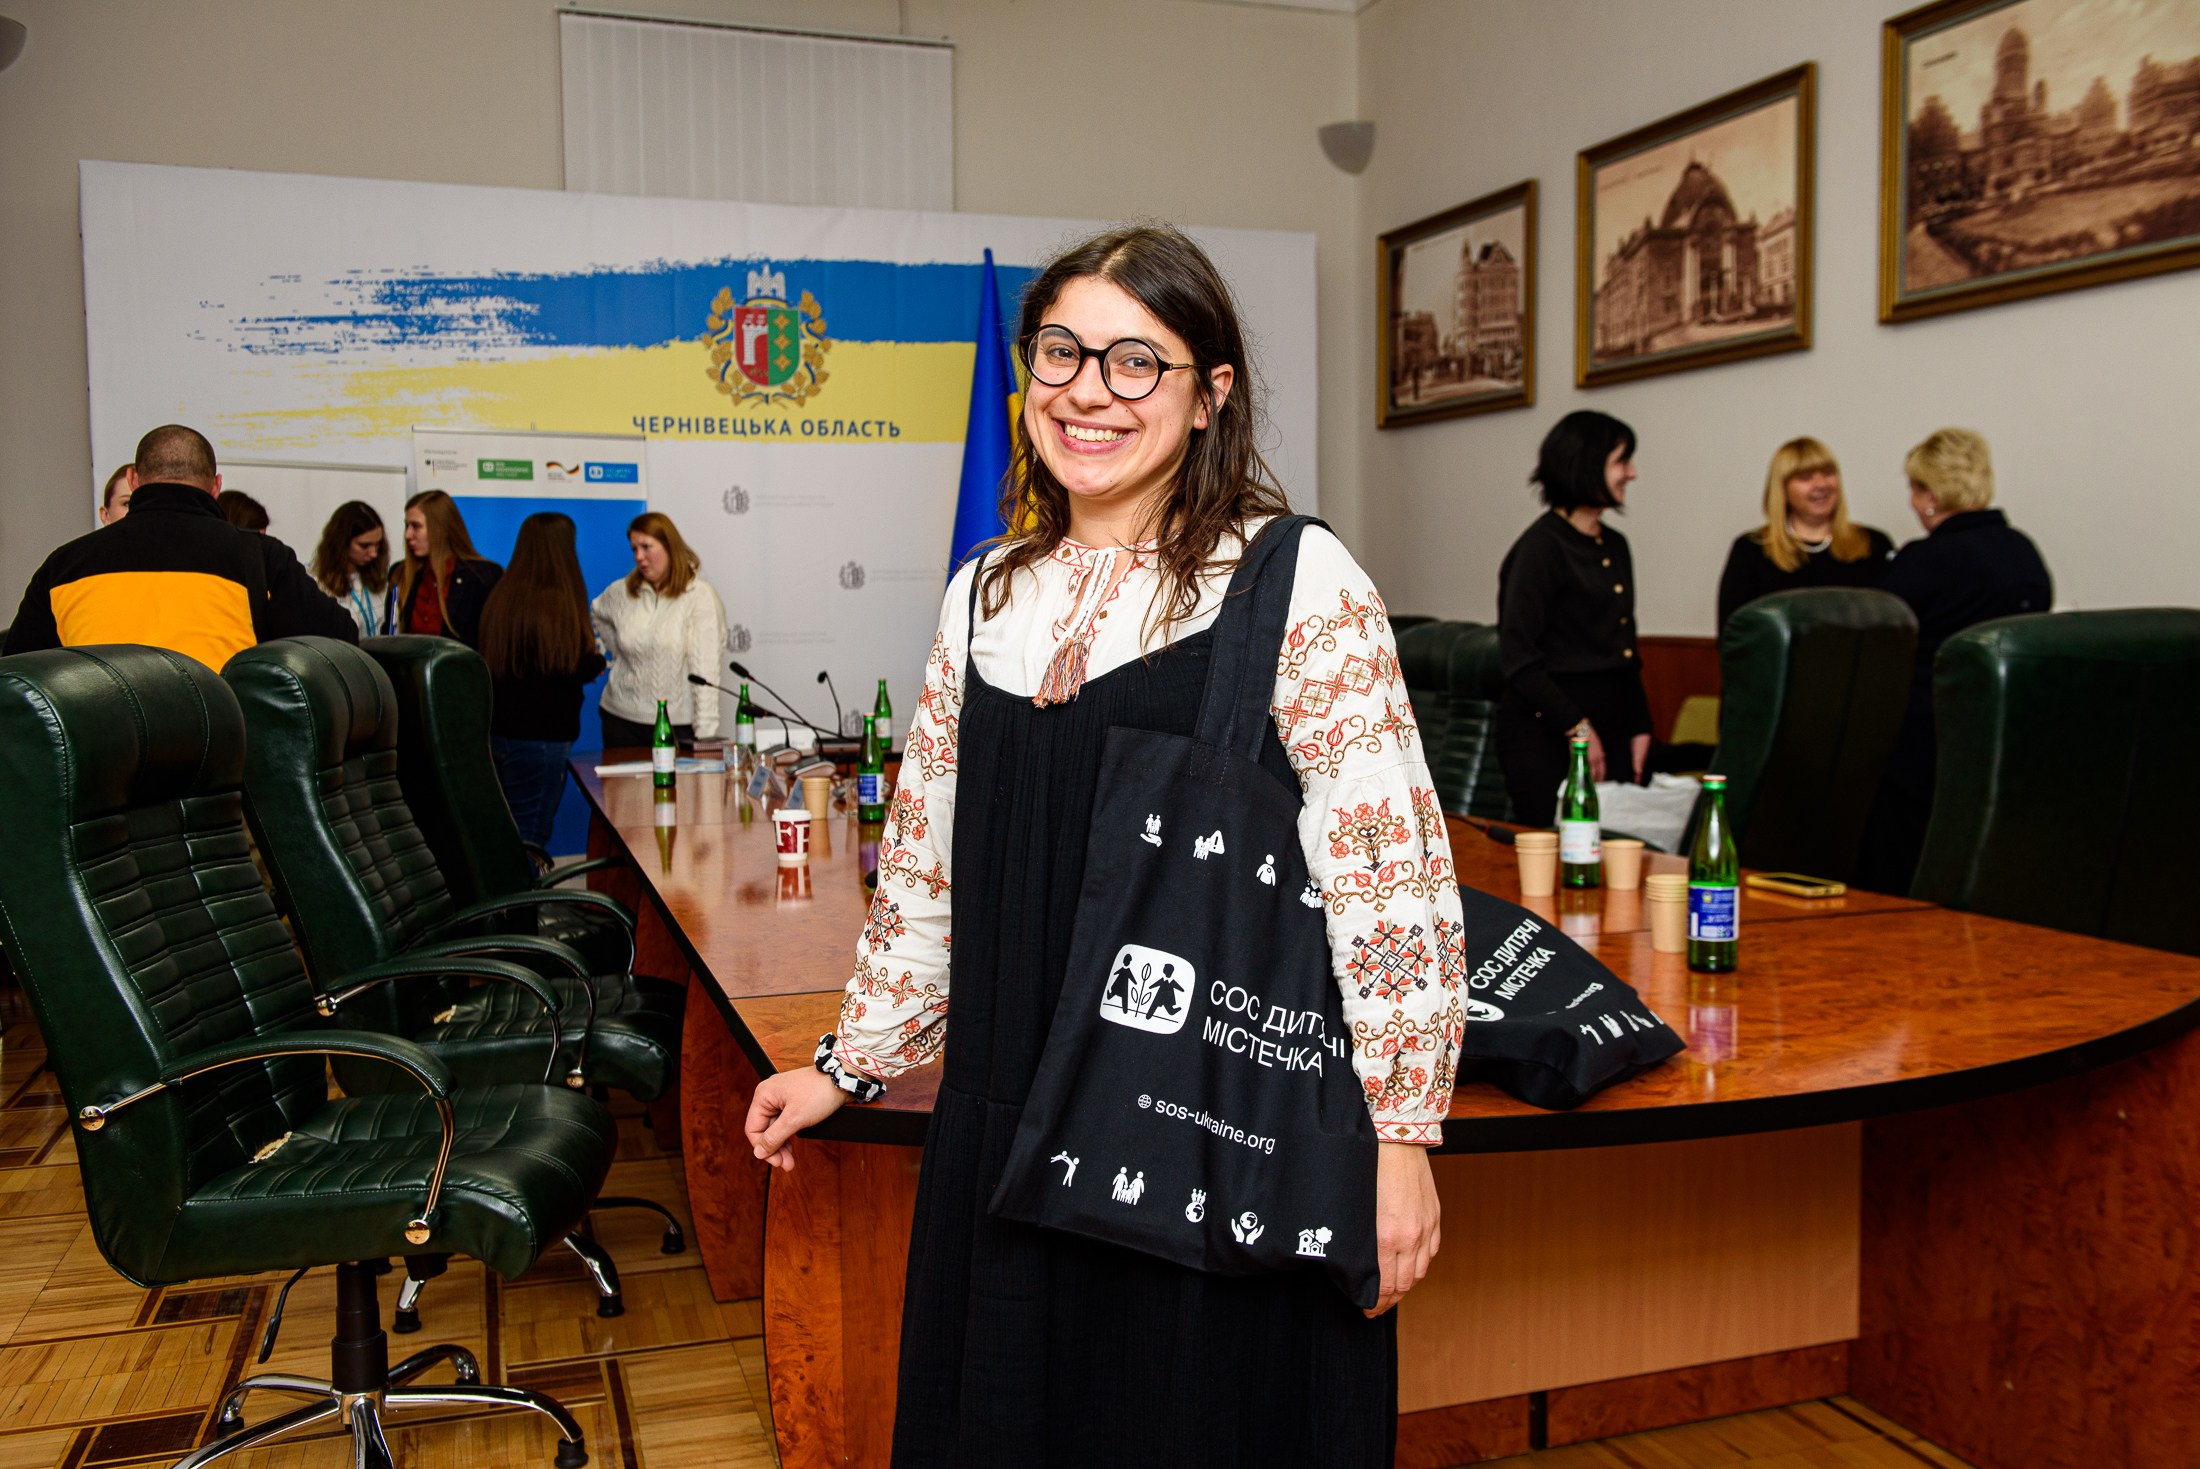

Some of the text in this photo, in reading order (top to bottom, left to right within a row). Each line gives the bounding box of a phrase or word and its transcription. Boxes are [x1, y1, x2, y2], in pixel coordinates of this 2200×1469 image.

[632, 416, 901, 438] ЧЕРНІВЕЦЬКА ОБЛАСТЬ
[1469, 918, 1542, 989] СОС ДИТЯЧІ
[1494, 947, 1556, 1001] МІСТЕЧКА
[1210, 980, 1260, 1021] СОС
[1202, 1016, 1323, 1078] МІСТЕЧКА
[1155, 1100, 1276, 1155] sos-ukraine.org
